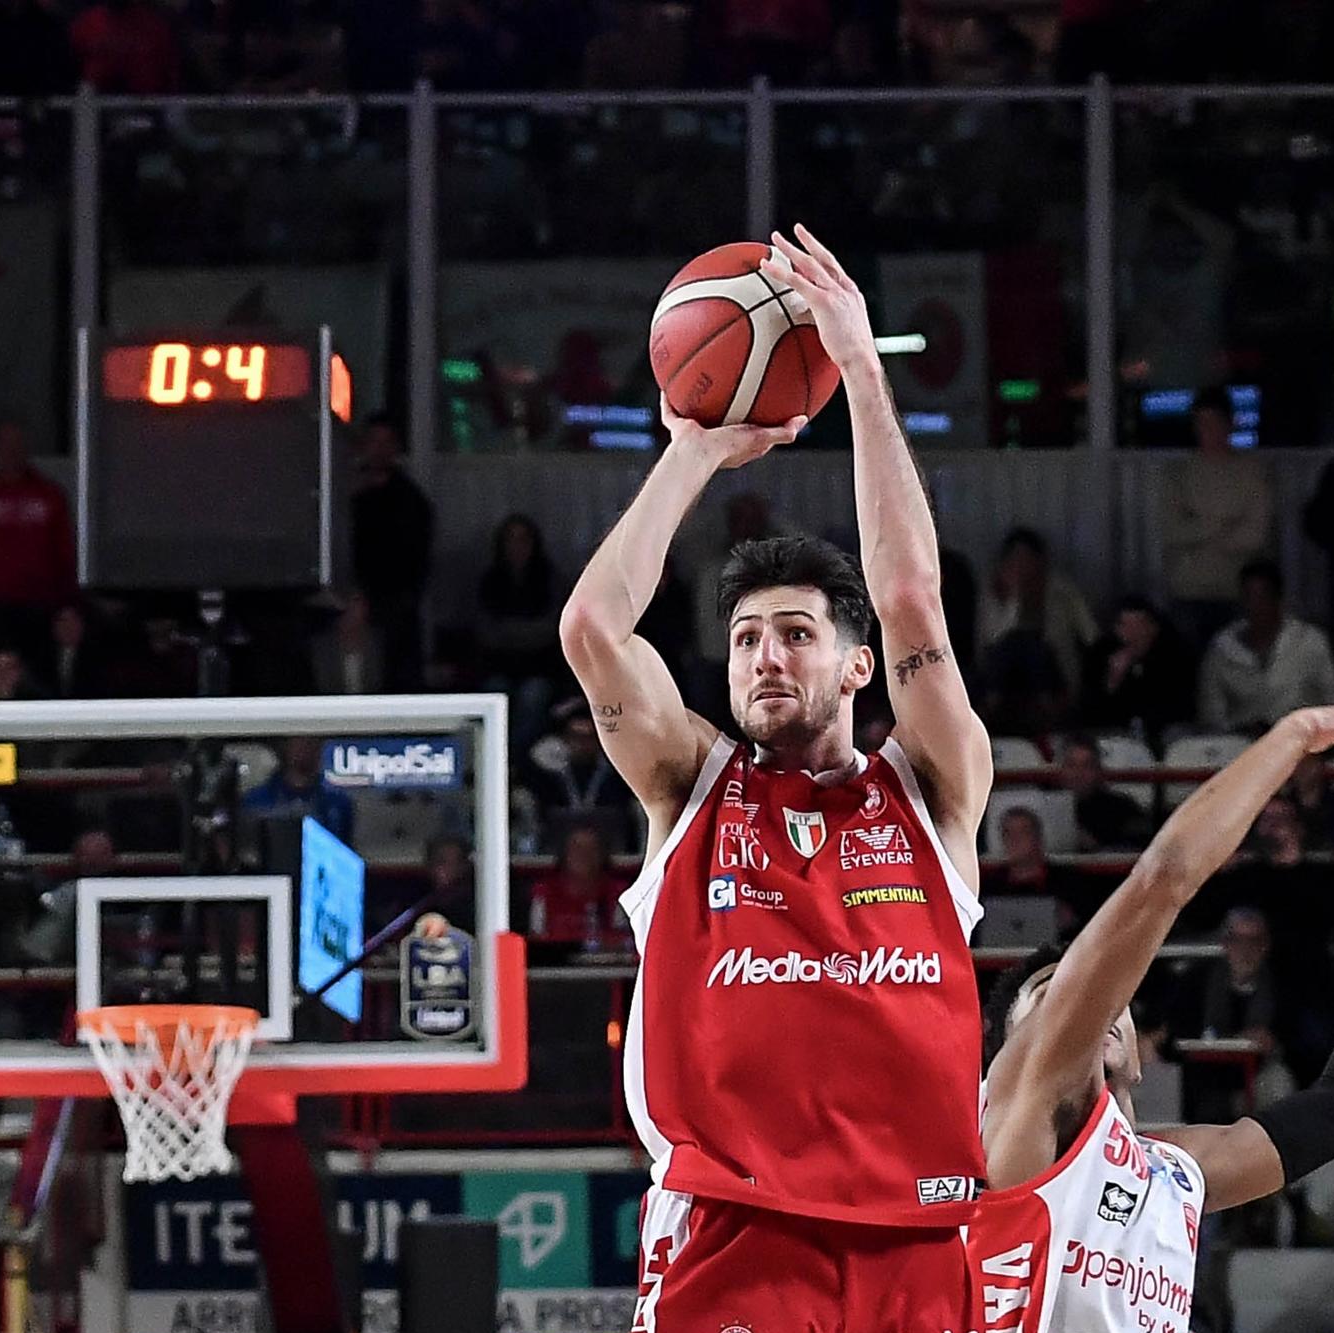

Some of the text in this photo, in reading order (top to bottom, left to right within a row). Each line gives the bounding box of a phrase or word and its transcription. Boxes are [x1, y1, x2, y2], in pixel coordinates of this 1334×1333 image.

[149, 343, 265, 404] 0:4
[840, 852, 914, 870] EYEWEAR
[740, 883, 784, 905] Group
[842, 883, 927, 908] SIMMENTHAL
[919, 1178, 963, 1197] EA7
